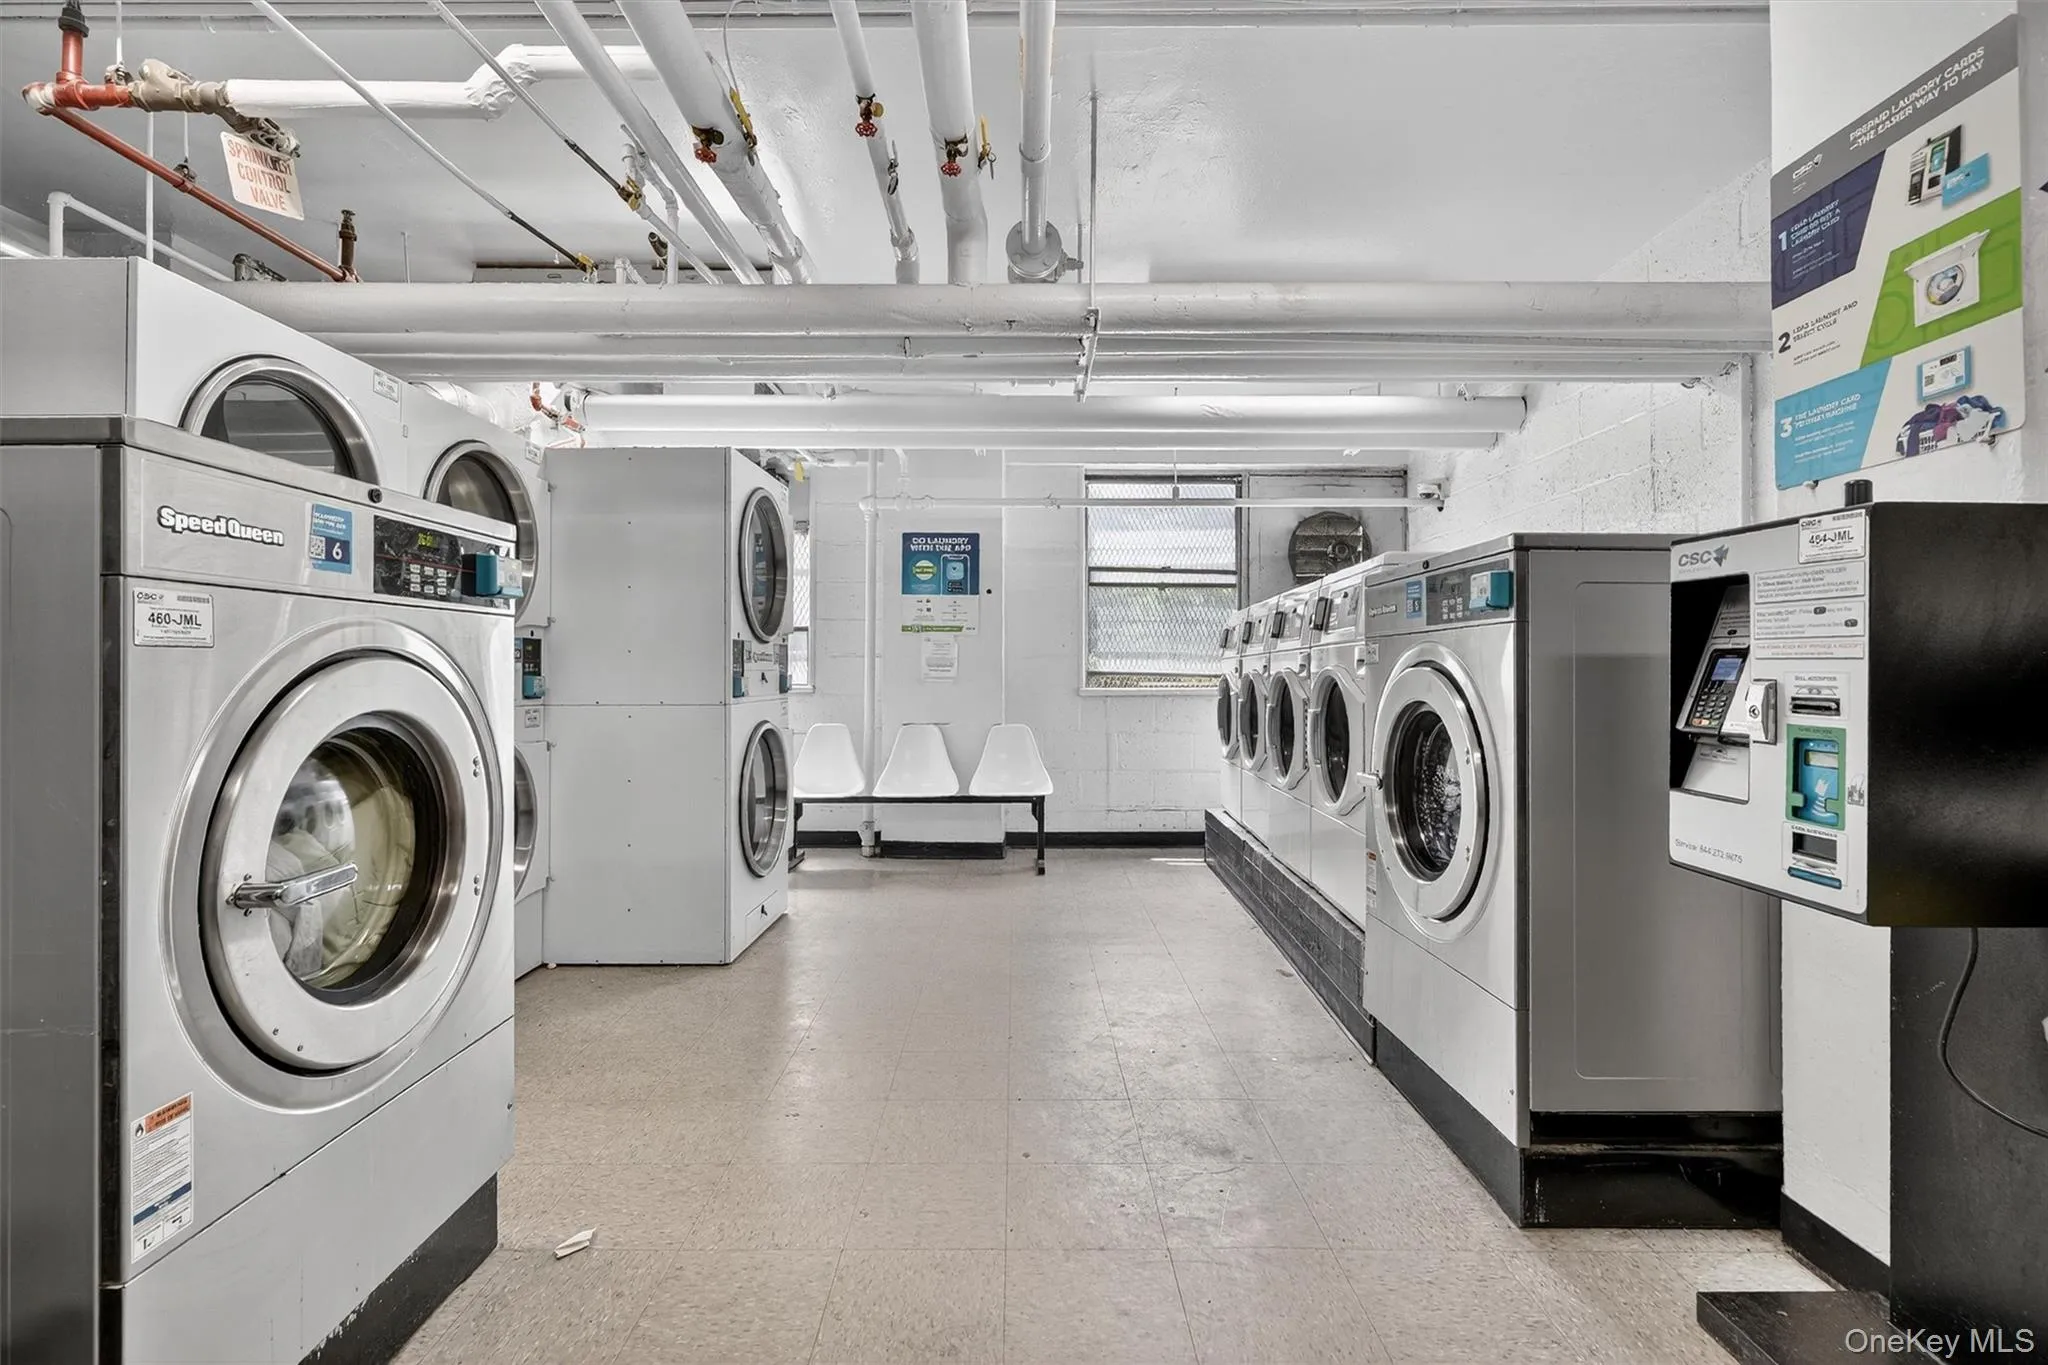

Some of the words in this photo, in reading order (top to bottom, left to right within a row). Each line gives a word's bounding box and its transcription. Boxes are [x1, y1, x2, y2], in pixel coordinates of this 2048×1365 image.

[1849, 110, 1889, 140] PREPAID
[1892, 74, 1941, 113] LAUNDRY
[1944, 46, 1984, 78] CARDS
[1915, 87, 1941, 108] WAY
[1943, 76, 1959, 91] TO
[1961, 58, 1984, 79] PAY
[237, 163, 291, 193] CONTROL
[250, 185, 288, 211] VALVE
[1778, 231, 1788, 251] 1
[1843, 300, 1858, 312] AND
[1778, 331, 1791, 353] 2
[1780, 417, 1792, 437] 3
[333, 542, 342, 560] 6
[927, 537, 969, 545] LAUNDRY
[954, 544, 971, 552] APP
[1678, 550, 1712, 568] CSC
[148, 612, 202, 627] 460-JML
